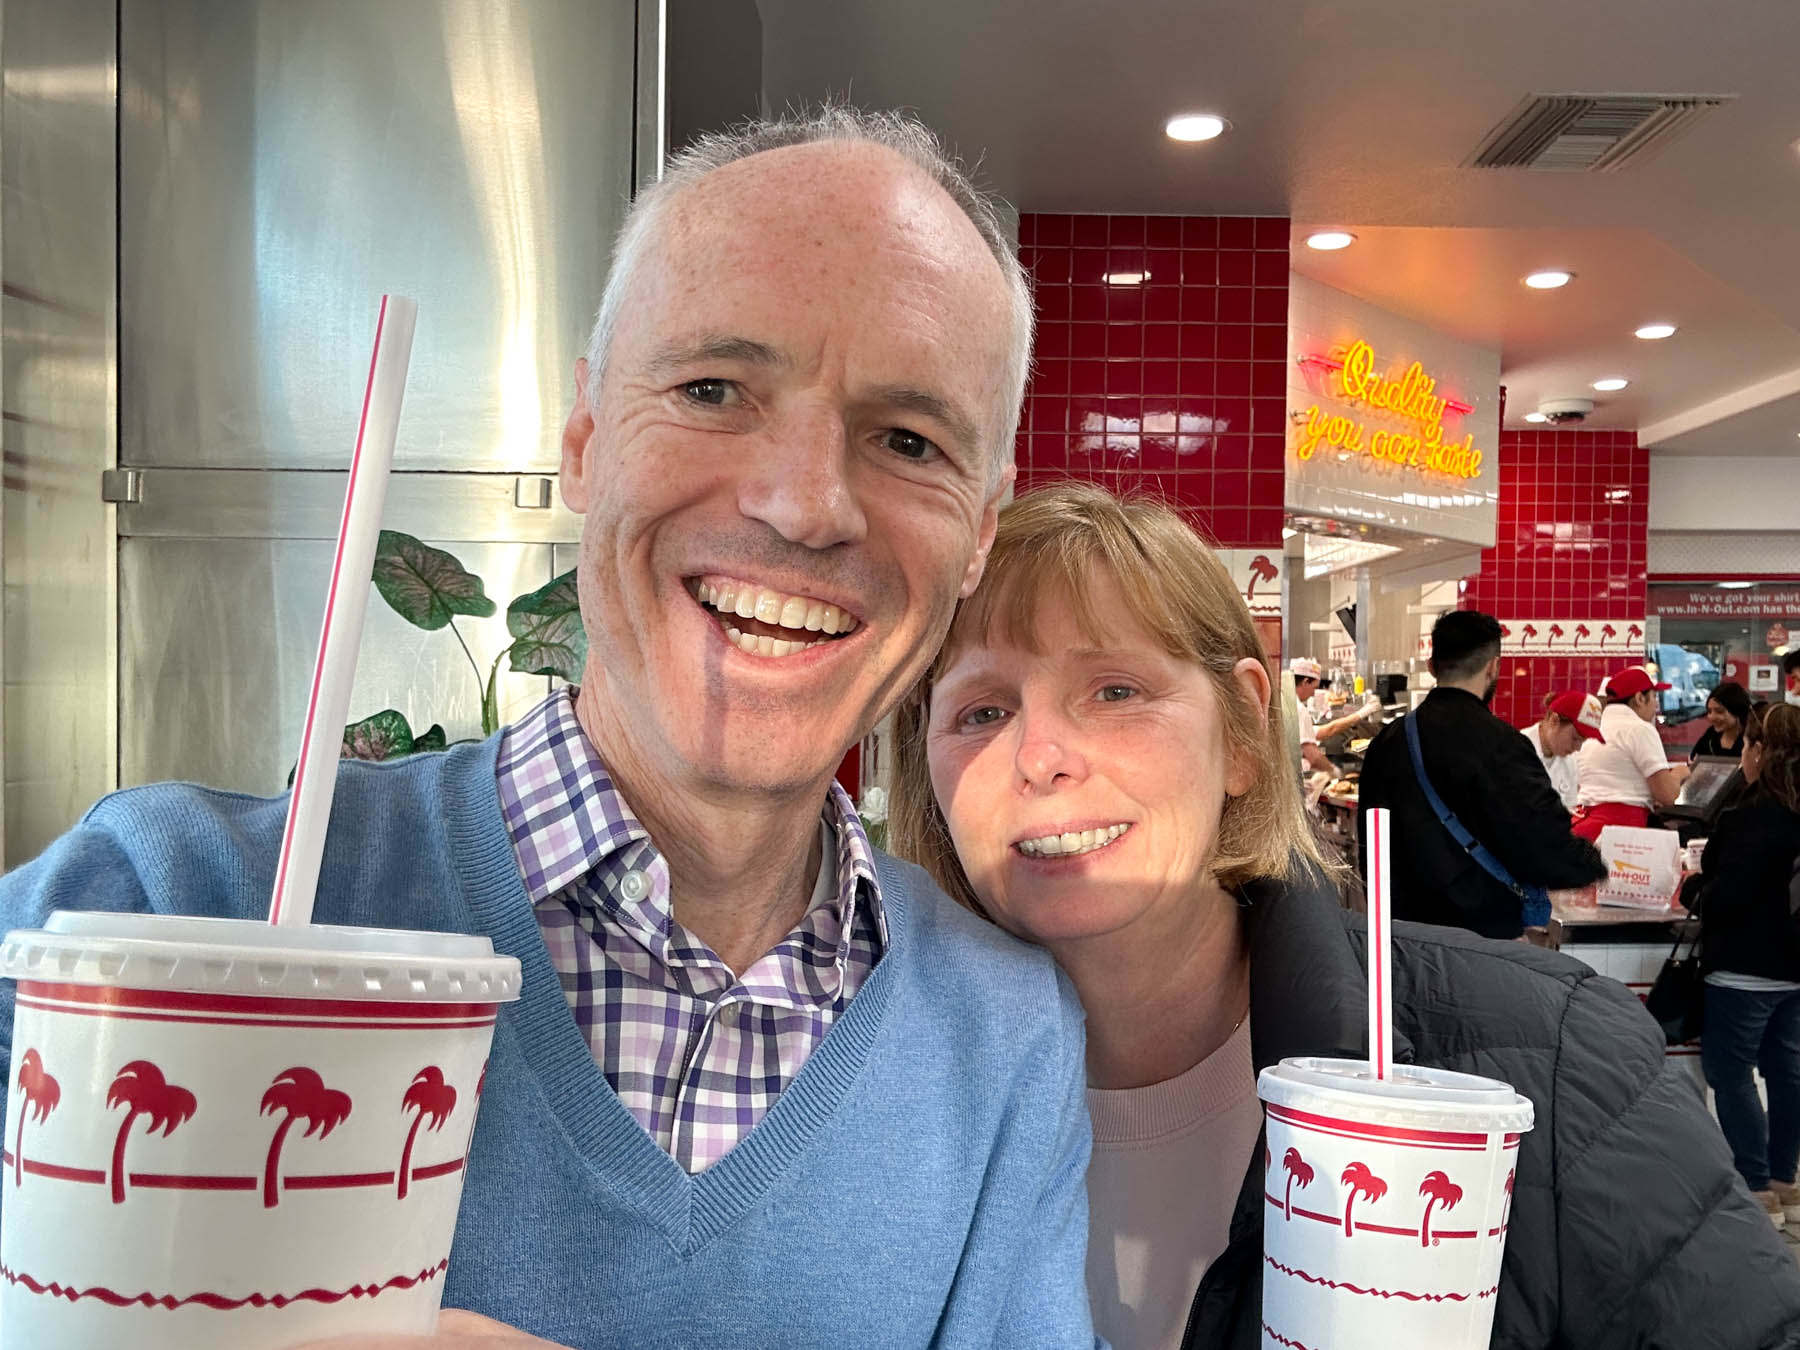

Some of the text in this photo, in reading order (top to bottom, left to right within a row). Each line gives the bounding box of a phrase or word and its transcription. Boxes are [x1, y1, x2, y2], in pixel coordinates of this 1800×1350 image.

[1343, 340, 1447, 438] Quality
[1299, 405, 1482, 478] you can taste
[1657, 604, 1761, 615] www.In-N-Out.com
[1763, 604, 1783, 614] has
[1689, 593, 1722, 603] We've
[1724, 593, 1744, 605] got
[1747, 594, 1770, 605] your
